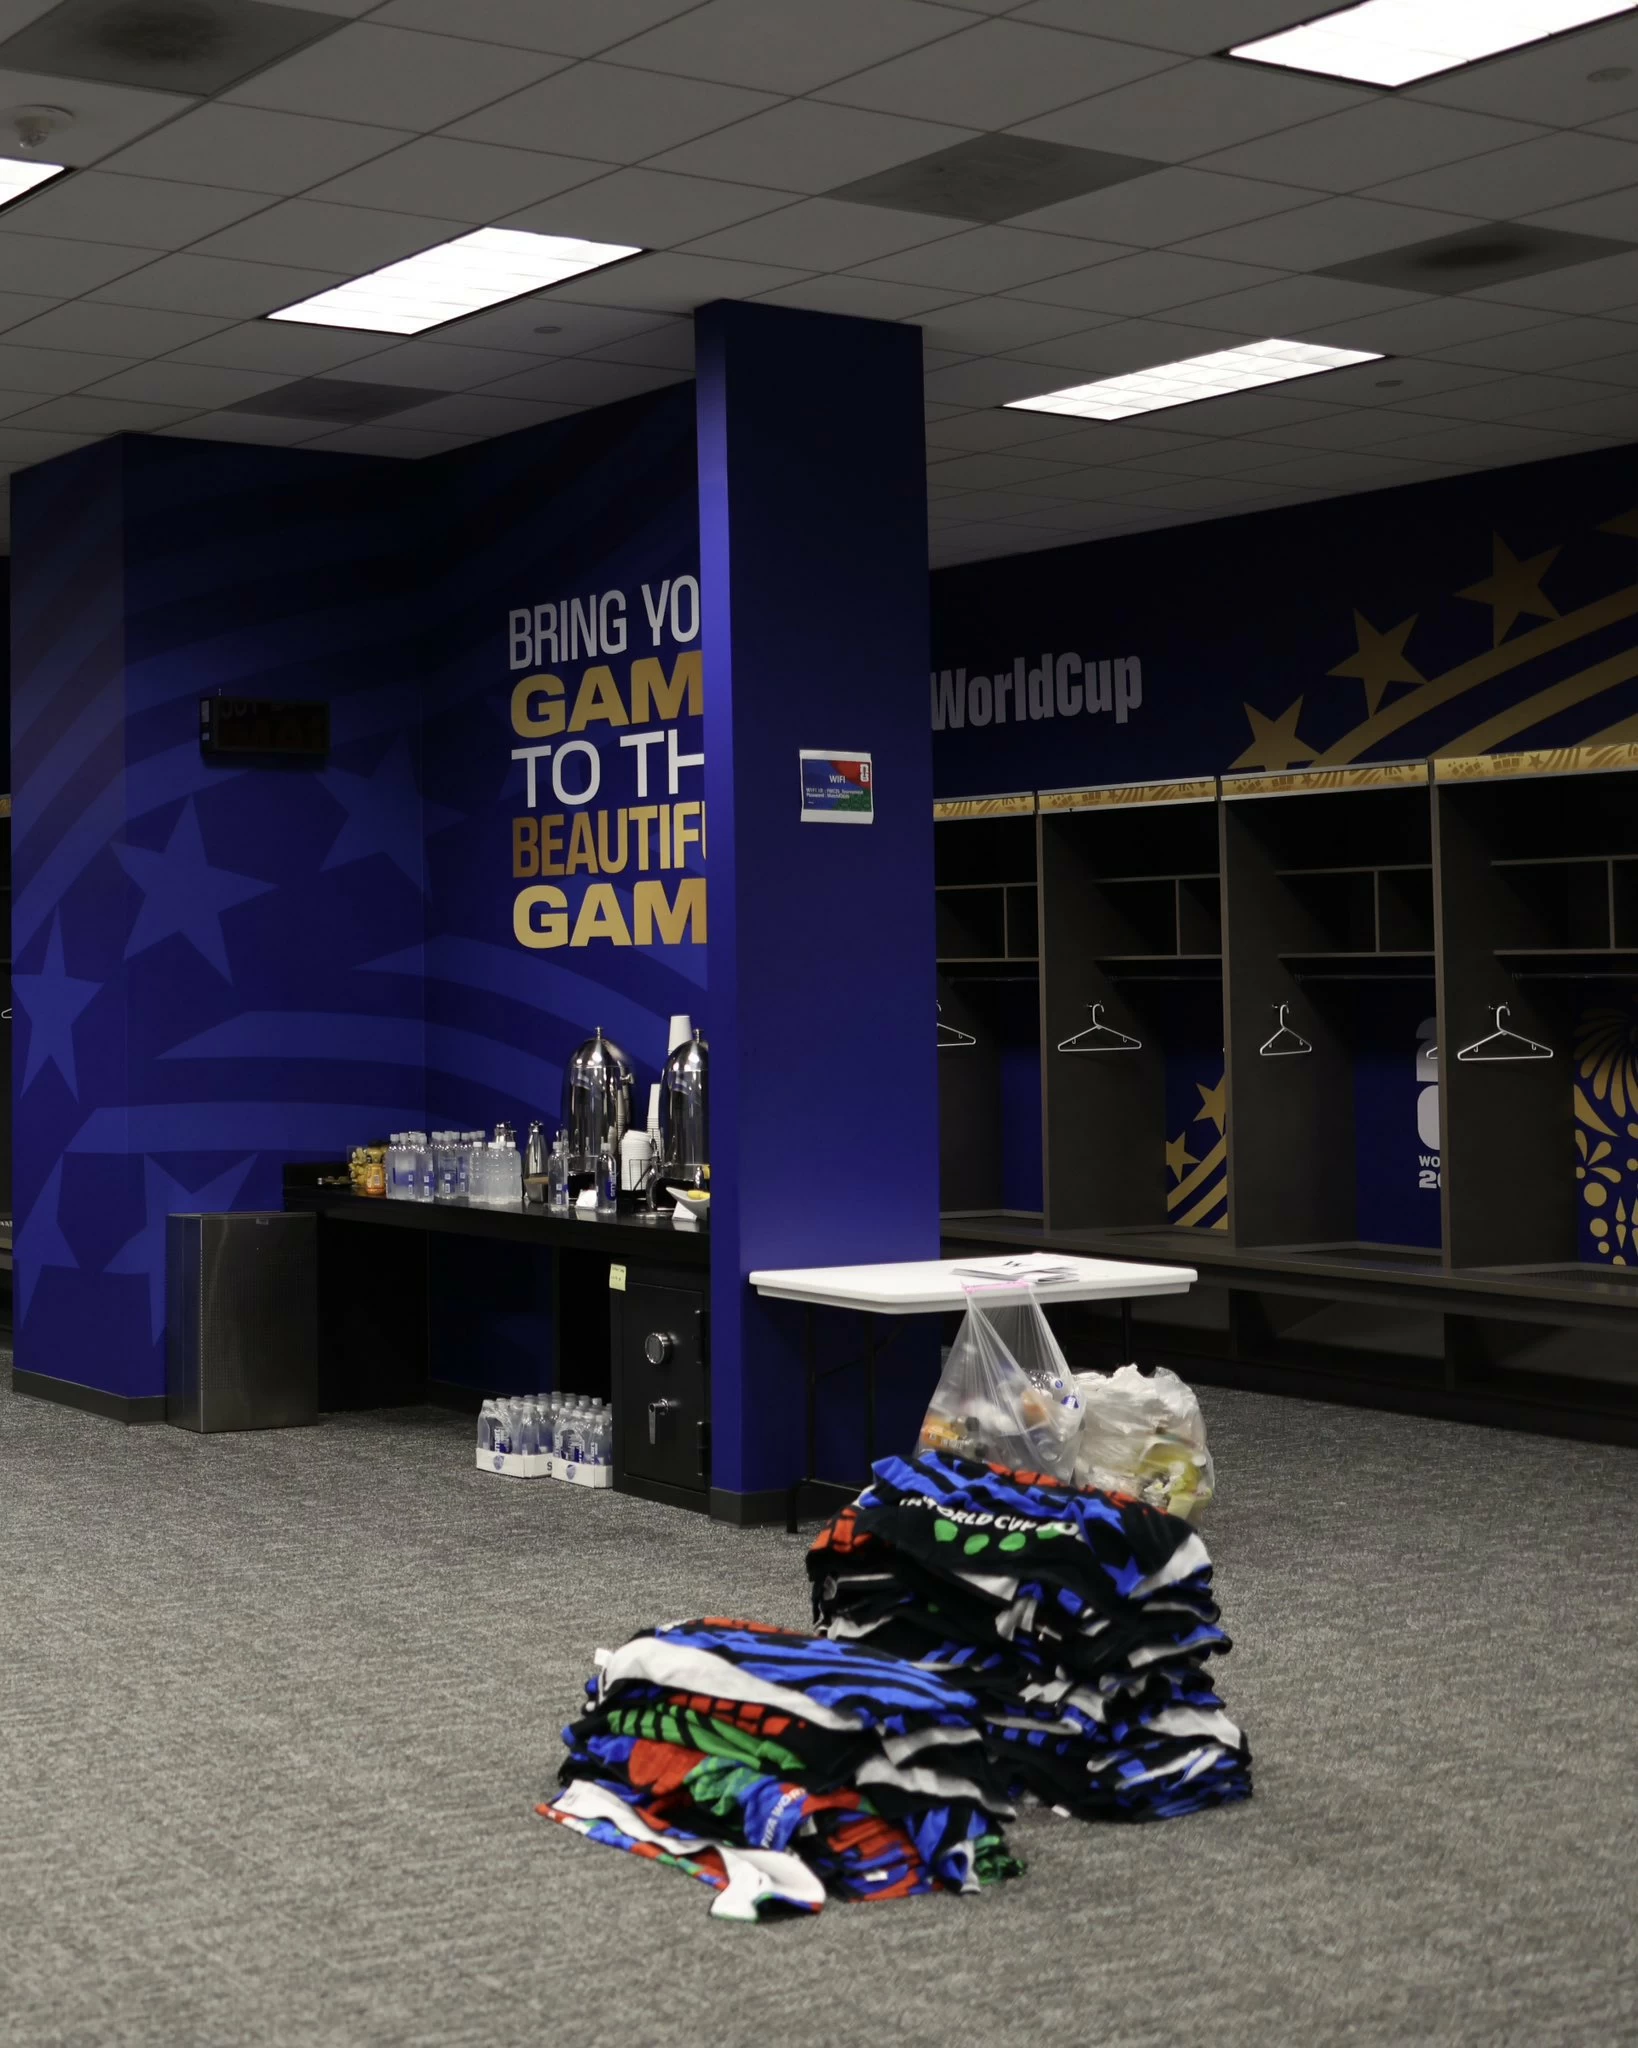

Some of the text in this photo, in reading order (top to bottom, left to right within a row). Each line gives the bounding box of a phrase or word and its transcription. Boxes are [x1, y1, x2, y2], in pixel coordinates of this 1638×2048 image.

[508, 575, 700, 670] BRING YO
[510, 650, 704, 738] GAM
[930, 652, 1143, 731] WorldCup
[511, 729, 705, 808] TO TH
[512, 801, 706, 878] BEAUTIF
[513, 877, 707, 949] GAM
[1418, 1170, 1441, 1189] 2
